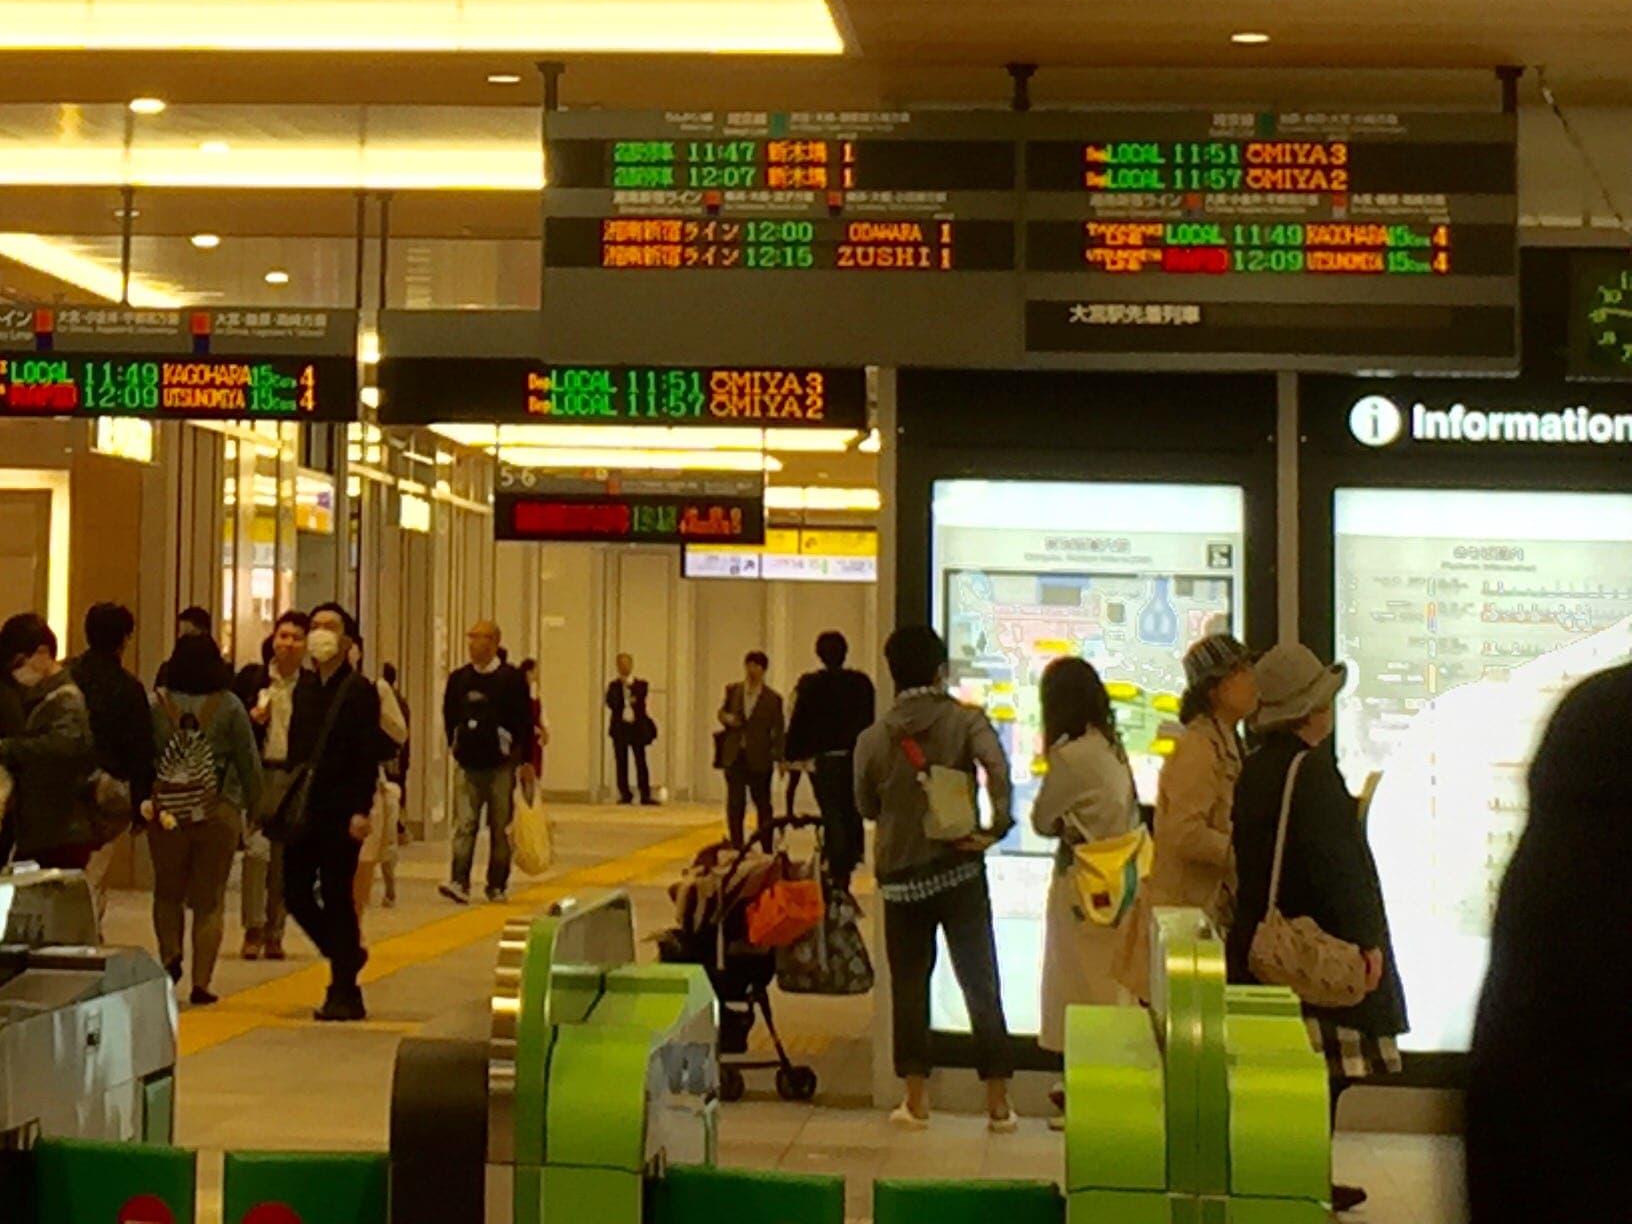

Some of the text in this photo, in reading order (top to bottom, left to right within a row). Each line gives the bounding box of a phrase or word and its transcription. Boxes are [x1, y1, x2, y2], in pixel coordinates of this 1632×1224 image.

[689, 142, 755, 163] 11:47
[843, 142, 855, 163] 1
[1105, 143, 1166, 164] LOCAL
[1174, 143, 1240, 165] 11:51
[1330, 142, 1348, 165] 3
[689, 166, 756, 187] 12:07
[843, 167, 855, 188] 1
[1105, 167, 1166, 189] LOCAL
[1174, 168, 1242, 190] 11:57
[1330, 167, 1348, 190] 2
[747, 221, 814, 242] 12:00
[940, 222, 952, 244] 1
[1165, 223, 1227, 245] LOCAL
[1234, 223, 1304, 245] 11:49
[1432, 224, 1449, 246] 4
[747, 245, 814, 267] 12:15
[837, 246, 931, 267] ZUSHI
[940, 247, 952, 269] 1
[1234, 249, 1304, 272] 12:09
[1432, 250, 1449, 273] 4
[10, 361, 75, 383] LOCAL
[163, 363, 252, 386] KAGOHARA
[299, 364, 315, 386] 4
[551, 370, 617, 394] LOCAL
[628, 370, 701, 394] 11:51
[805, 371, 824, 394] 3
[85, 385, 159, 409] 12:09
[299, 386, 315, 411] 4
[551, 392, 617, 416] LOCAL
[628, 393, 706, 417] 11:57
[805, 394, 824, 419] 2
[1412, 402, 1632, 444] Information
